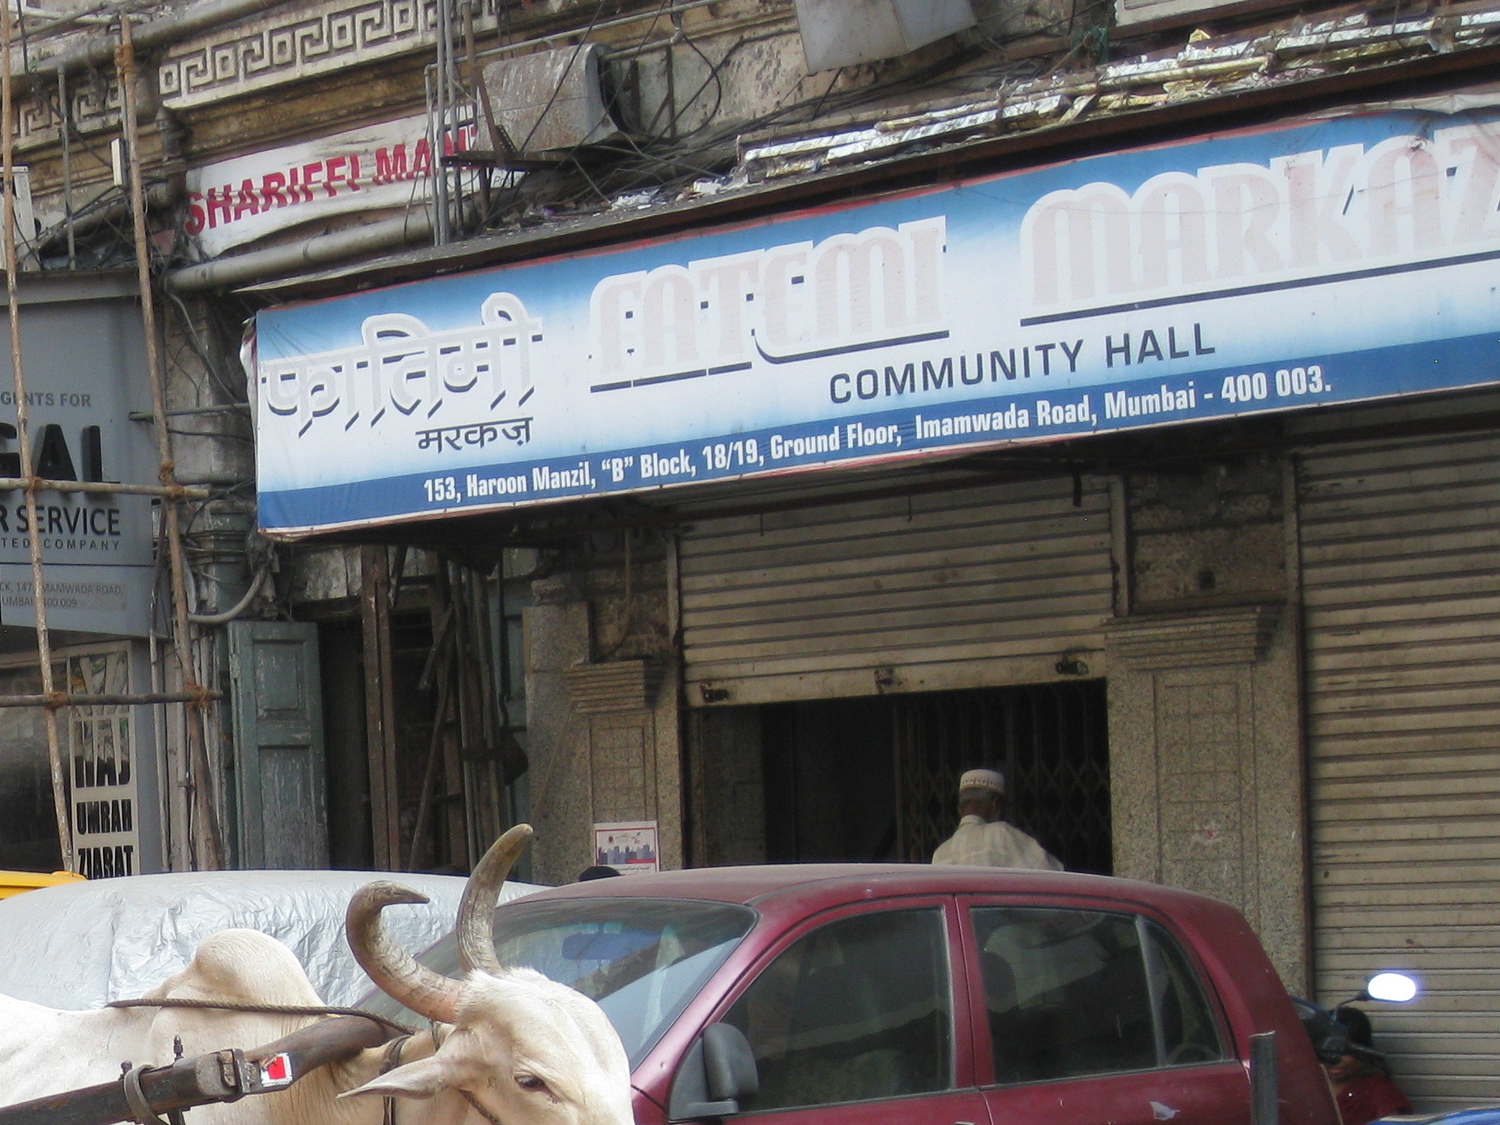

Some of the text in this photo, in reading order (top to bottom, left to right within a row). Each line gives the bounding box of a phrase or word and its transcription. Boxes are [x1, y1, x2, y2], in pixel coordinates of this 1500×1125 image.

[184, 125, 478, 236] SHARIFFI MAN
[261, 291, 544, 438] फातिमी
[829, 322, 1216, 404] COMMUNITY HALL
[60, 393, 91, 408] FOR
[415, 416, 535, 454] मरकज़
[423, 476, 462, 504] 153,
[466, 472, 528, 498] Haroon
[532, 461, 597, 492] Manzil,
[640, 448, 697, 479] Block,
[702, 438, 765, 472] 18/19,
[770, 421, 842, 459] Ground
[846, 420, 903, 449] Floor,
[915, 402, 1031, 441] Imamwada
[1036, 395, 1098, 428] Road,
[1105, 380, 1197, 421] Mumbai
[1221, 372, 1268, 404] 400
[1275, 365, 1333, 398] 003.
[44, 538, 120, 550] COMPANY
[73, 718, 131, 789] HAJ
[76, 799, 133, 836] UMRAH
[77, 845, 134, 880] ZIARAT
